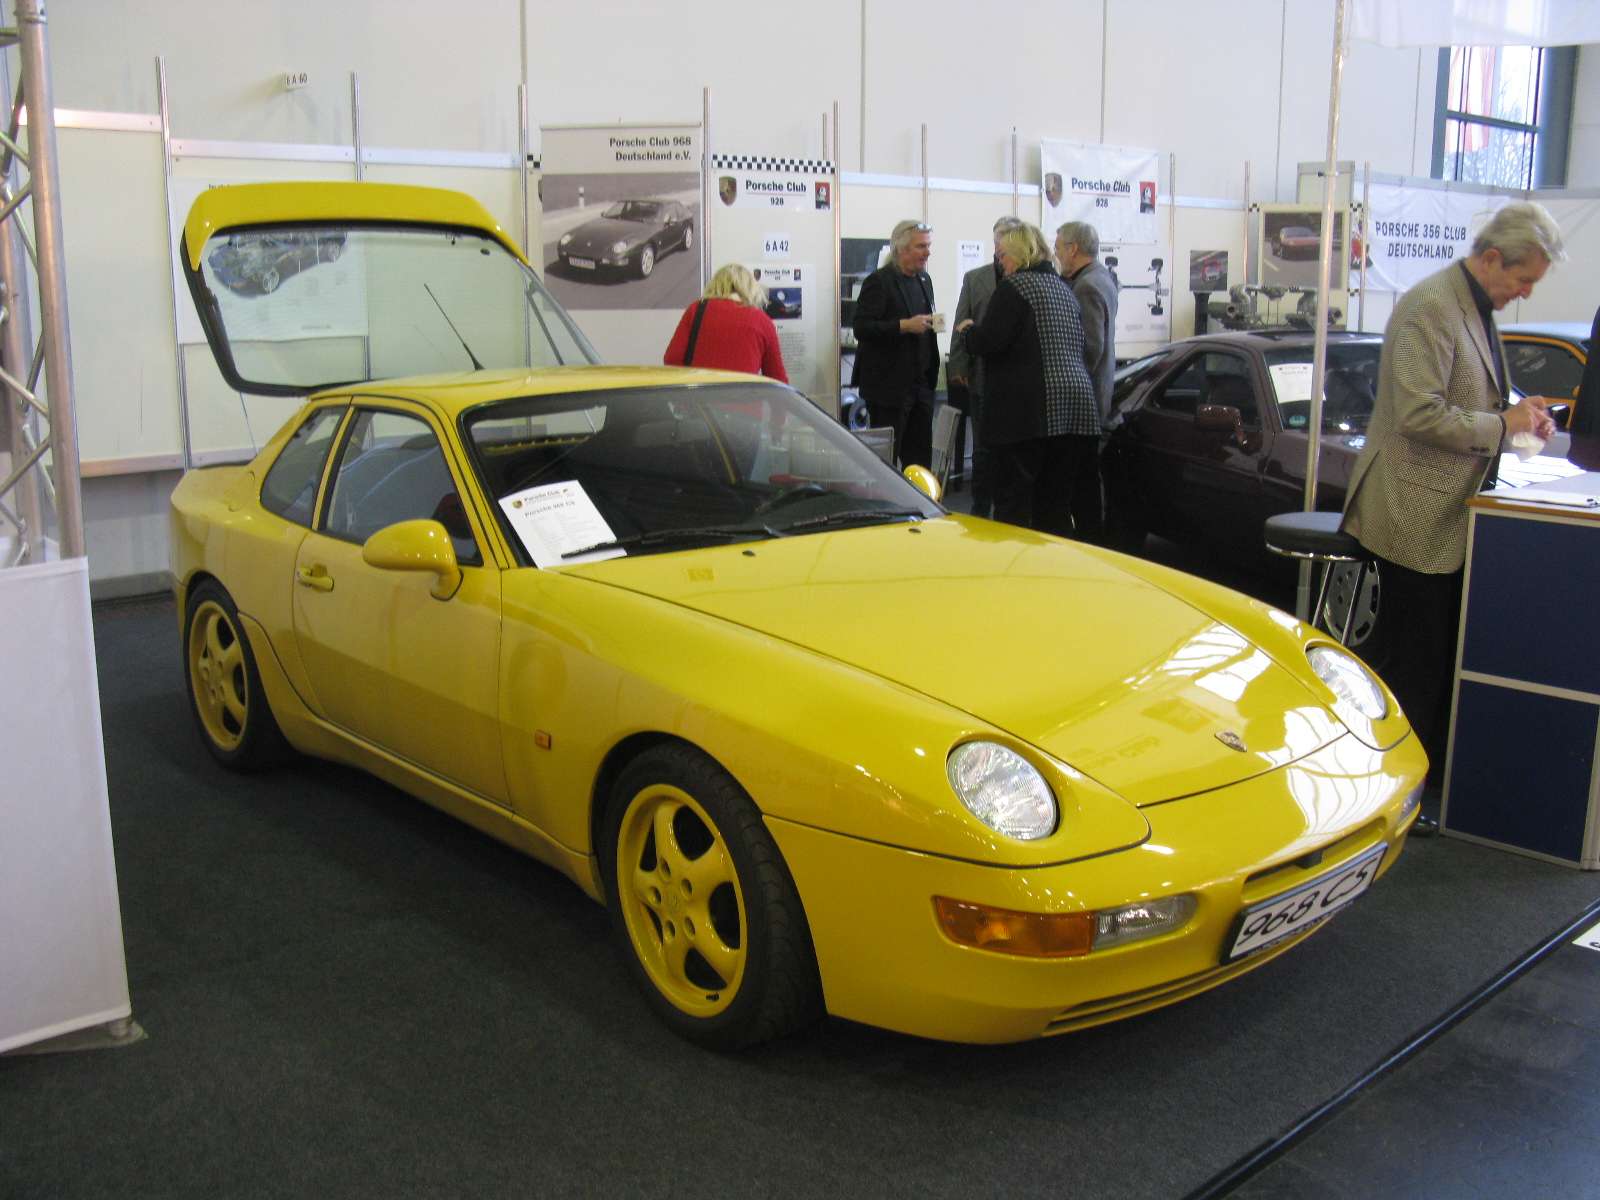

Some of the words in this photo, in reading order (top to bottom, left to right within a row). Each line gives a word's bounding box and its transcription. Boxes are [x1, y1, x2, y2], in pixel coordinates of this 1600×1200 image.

[292, 73, 297, 84] A
[609, 137, 647, 148] Porsche
[649, 136, 670, 146] Club
[673, 136, 692, 146] 968
[615, 150, 672, 161] Deutschland
[675, 150, 691, 161] e.V.
[745, 180, 784, 192] Porsche
[786, 181, 807, 193] Club
[1071, 178, 1110, 192] Porsche
[1113, 180, 1131, 194] Club
[770, 197, 784, 206] 928
[1095, 197, 1109, 209] 928
[1375, 221, 1420, 238] PORSCHE
[1423, 224, 1440, 239] 356
[1444, 226, 1466, 240] CLUB
[765, 240, 771, 252] 6
[772, 240, 778, 252] A
[779, 239, 789, 252] 42
[1387, 242, 1454, 259] DEUTSCHLAND
[1236, 890, 1321, 947] 968
[1320, 857, 1379, 908] CS
